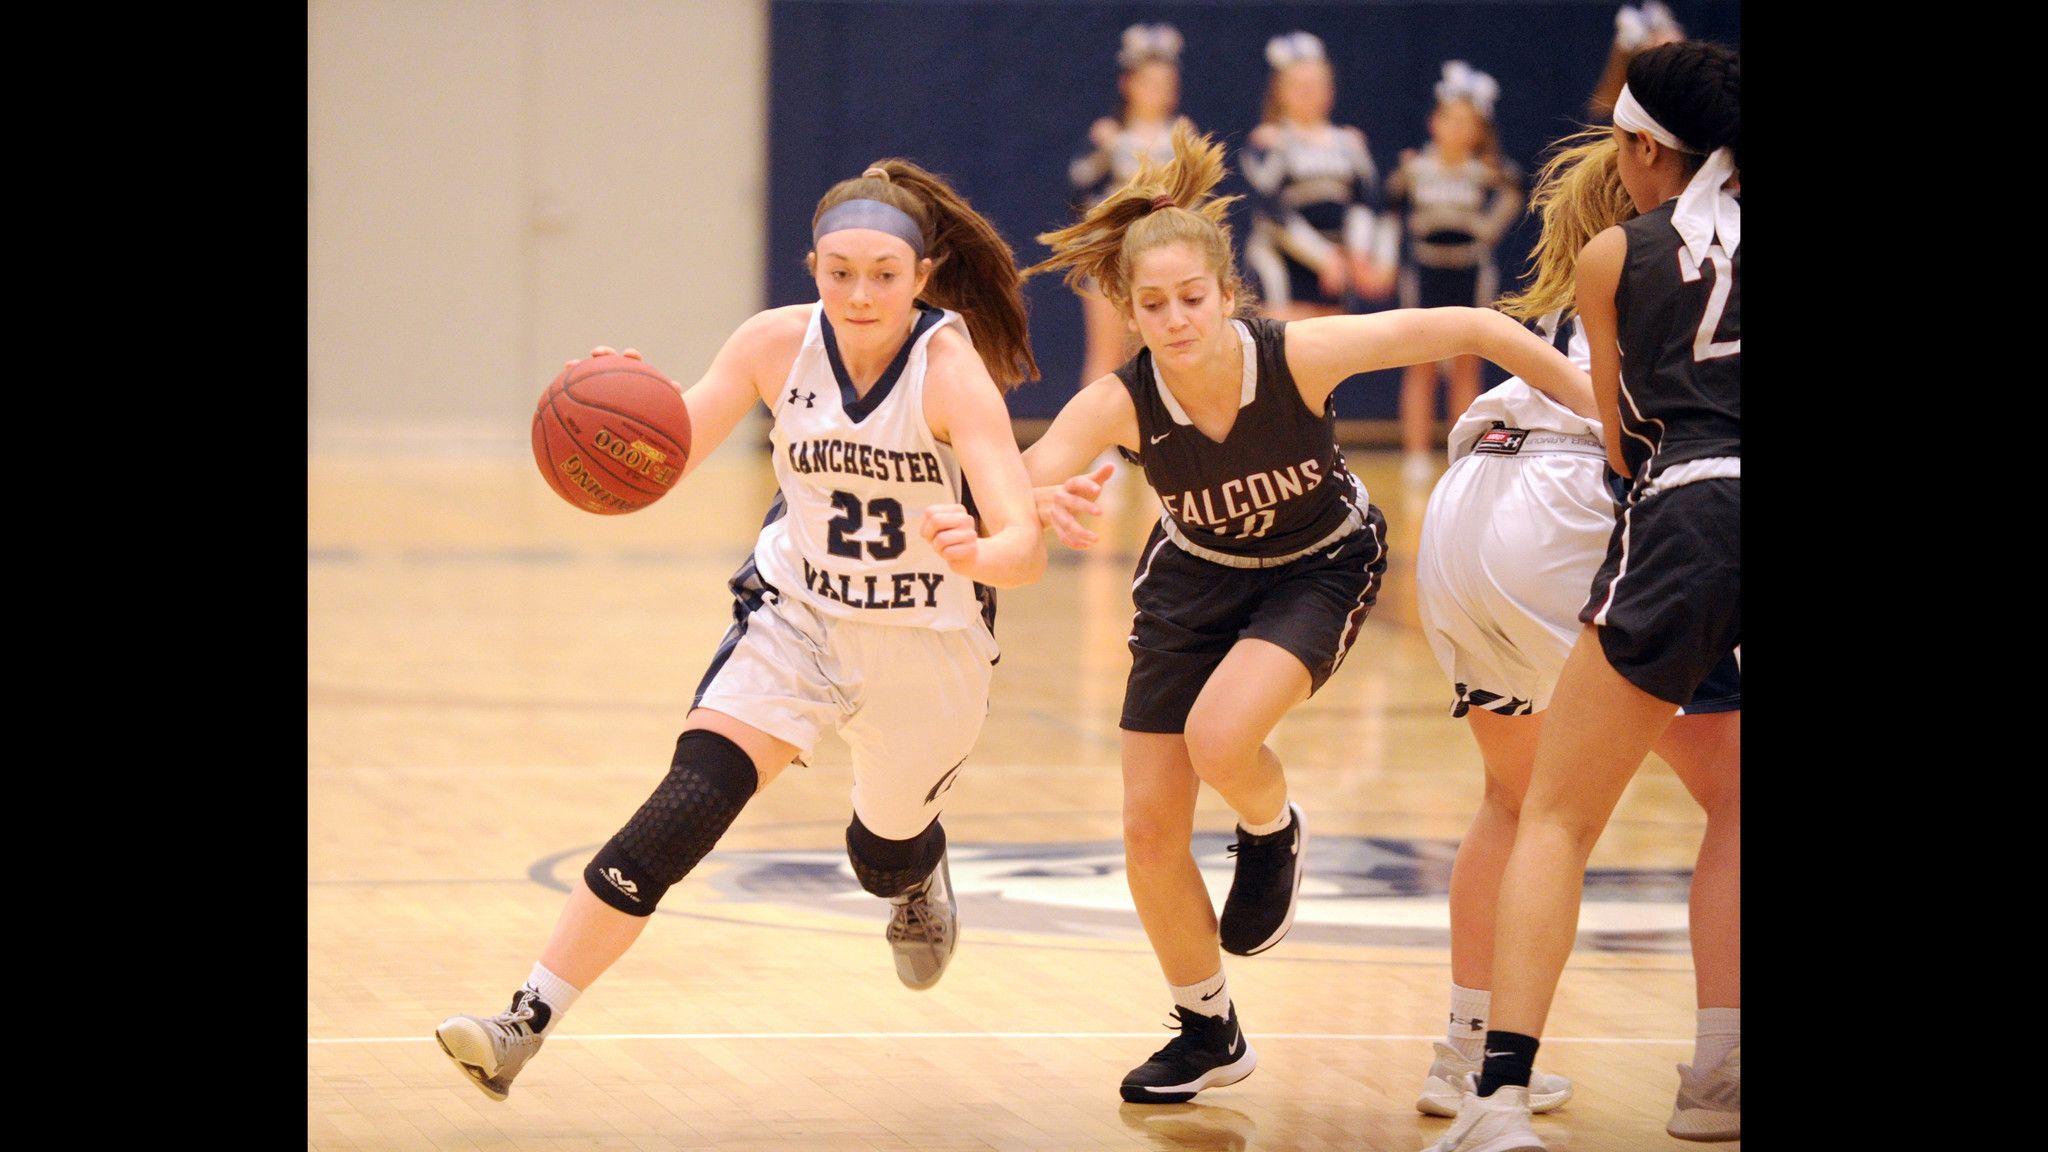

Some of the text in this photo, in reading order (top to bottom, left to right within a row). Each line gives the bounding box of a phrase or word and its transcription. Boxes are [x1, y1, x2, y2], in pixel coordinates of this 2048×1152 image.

[827, 489, 906, 561] 23
[1162, 458, 1322, 525] FALCONS
[802, 557, 944, 609] VALLEY
